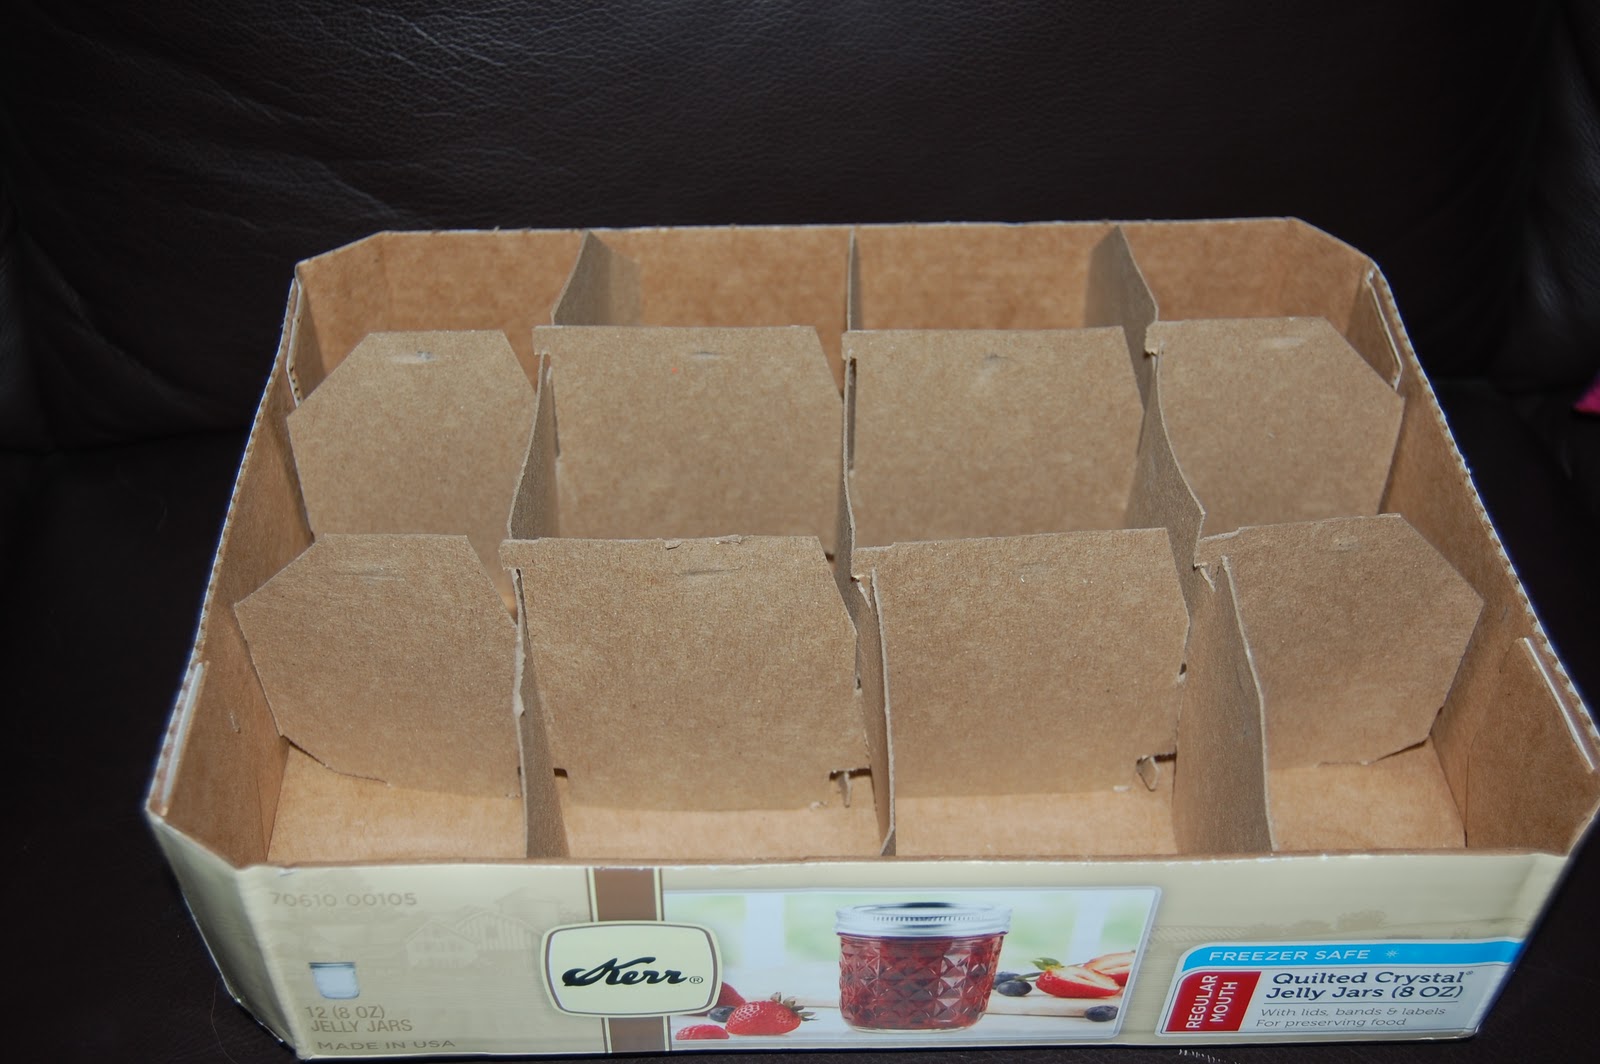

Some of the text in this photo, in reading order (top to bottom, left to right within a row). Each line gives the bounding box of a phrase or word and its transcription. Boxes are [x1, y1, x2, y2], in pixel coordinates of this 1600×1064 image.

[269, 891, 418, 908] 70610 00105
[1208, 949, 1371, 963] FREEZER SAFE
[1272, 971, 1369, 986] Quilted
[1265, 985, 1464, 1001] Jelly Jars (8 OZ)
[1185, 975, 1219, 1030] REGULAR
[1211, 981, 1239, 1024] MOUTH
[304, 1004, 386, 1020] 12 (8 OZ)
[1260, 1006, 1446, 1018] With lids, bands & labels
[310, 1018, 414, 1033] JELLY JARS
[1256, 1017, 1407, 1029] For preserving food
[317, 1038, 457, 1051] MADE IN USA
